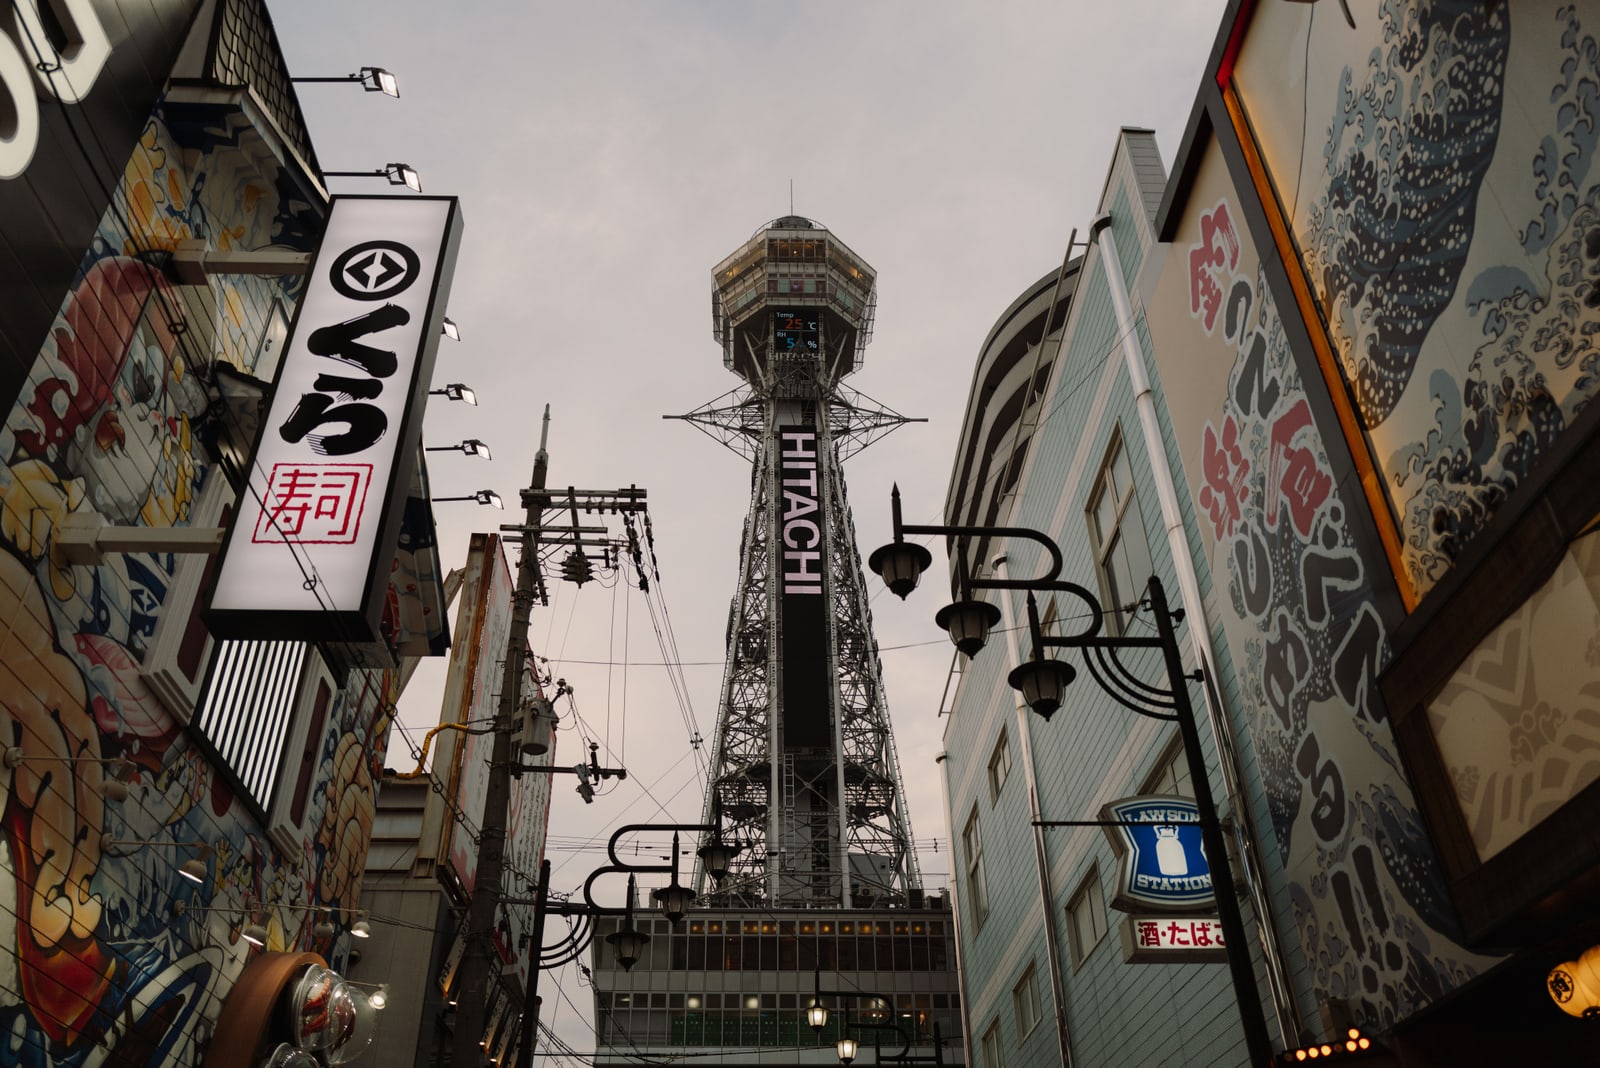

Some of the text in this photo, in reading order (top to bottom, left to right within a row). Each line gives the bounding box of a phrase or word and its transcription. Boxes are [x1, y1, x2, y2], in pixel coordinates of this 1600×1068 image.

[807, 340, 818, 349] %
[279, 302, 410, 456] くら
[264, 469, 361, 536] 寿司
[782, 433, 822, 594] HITACHI
[1125, 809, 1201, 823] LAWSON
[1137, 873, 1214, 891] STATION
